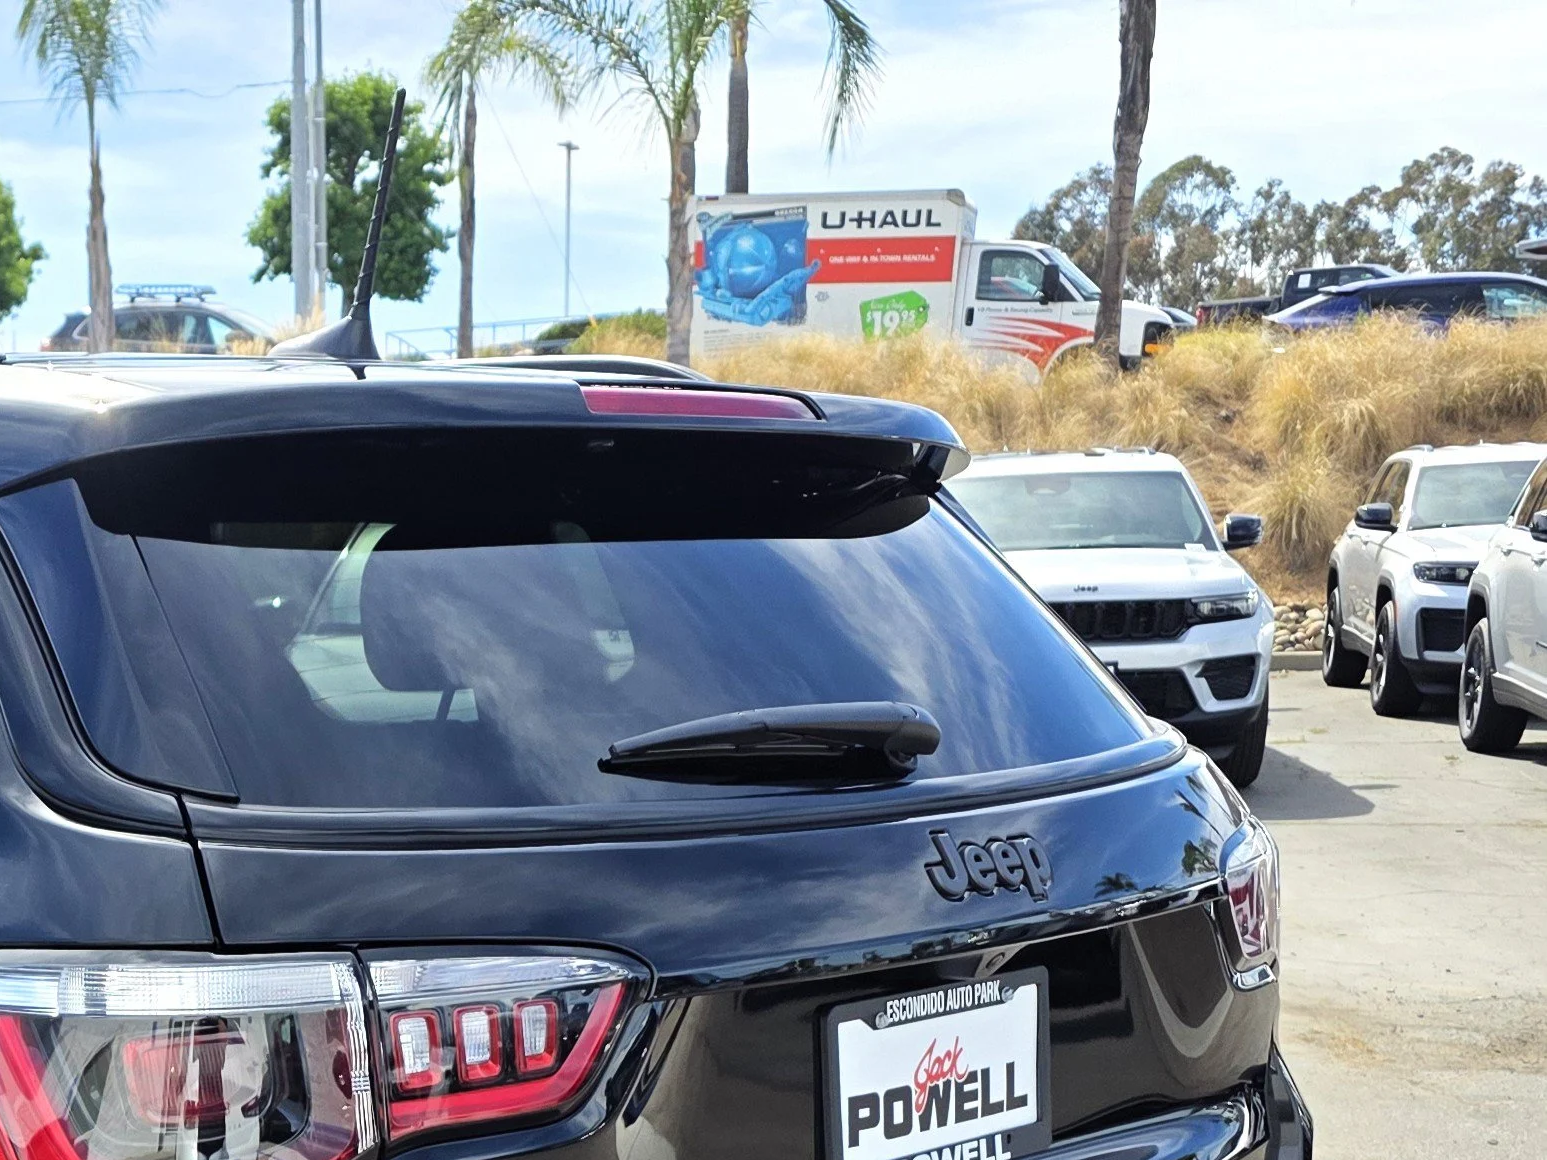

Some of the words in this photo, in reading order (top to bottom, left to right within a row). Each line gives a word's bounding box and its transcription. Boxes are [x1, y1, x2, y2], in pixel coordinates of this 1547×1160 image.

[821, 209, 941, 229] U-HAUL
[902, 253, 935, 262] RENTALS
[924, 828, 1053, 902] Jeep
[886, 991, 944, 1023] ESCONDIDO
[946, 986, 972, 1011] AUTO
[974, 980, 1001, 1005] PARK
[914, 1036, 969, 1113] Jack
[848, 1061, 1028, 1149] POWELL
